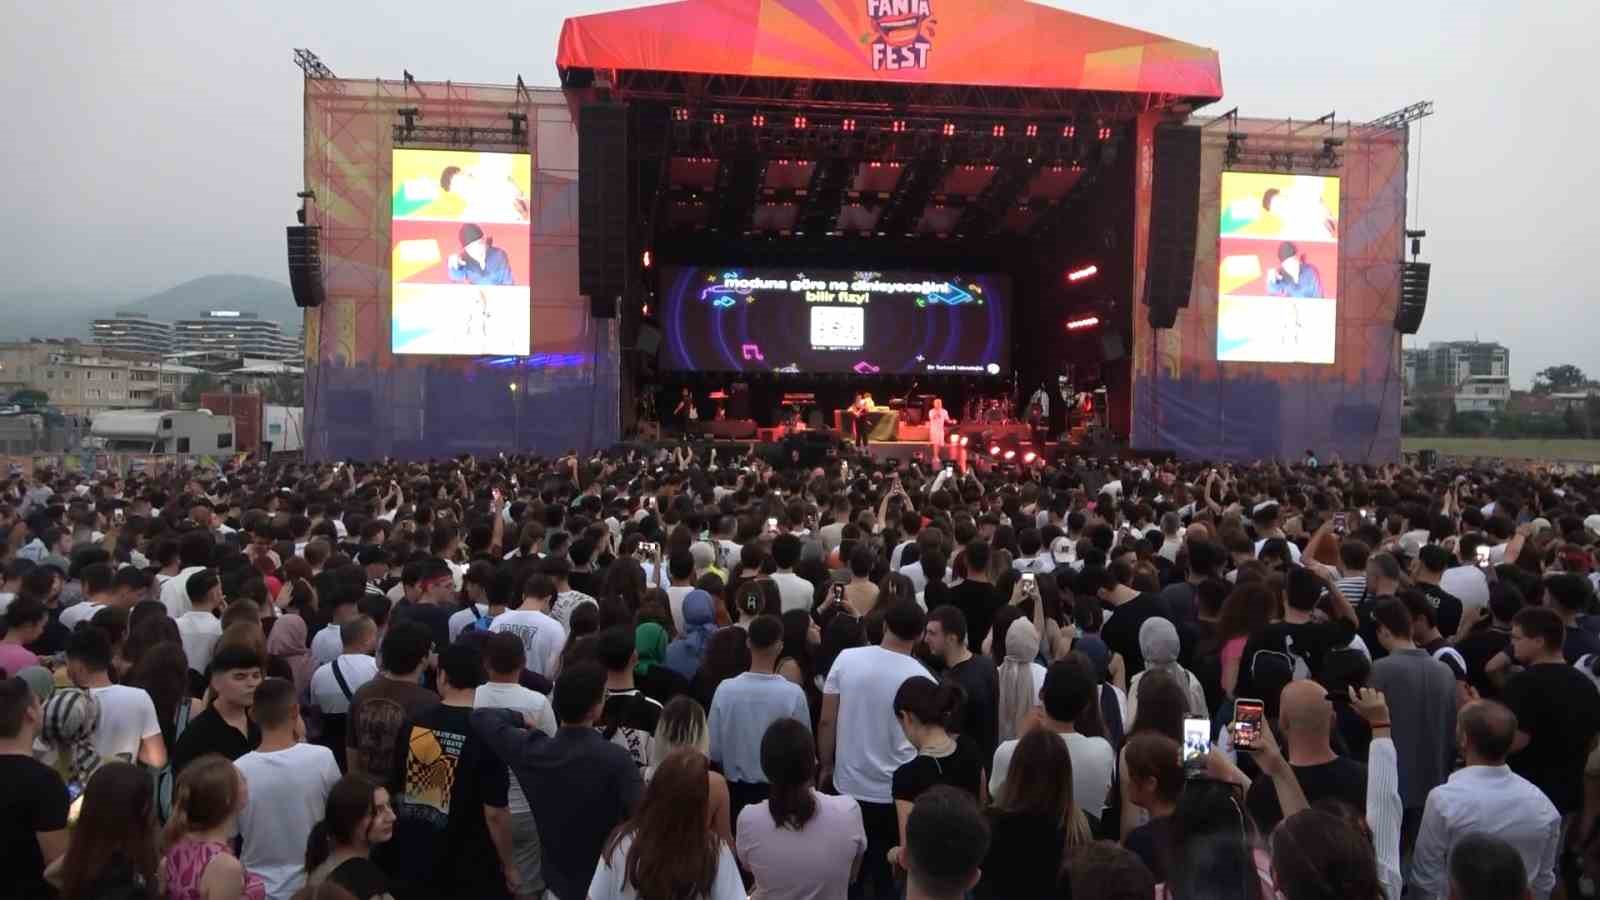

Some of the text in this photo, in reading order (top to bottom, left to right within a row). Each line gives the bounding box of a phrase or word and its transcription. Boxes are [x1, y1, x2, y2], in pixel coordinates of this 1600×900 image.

[872, 42, 930, 70] FEST
[724, 277, 787, 290] moduna
[790, 279, 826, 292] göre
[829, 280, 849, 291] ne
[805, 291, 834, 302] bilir
